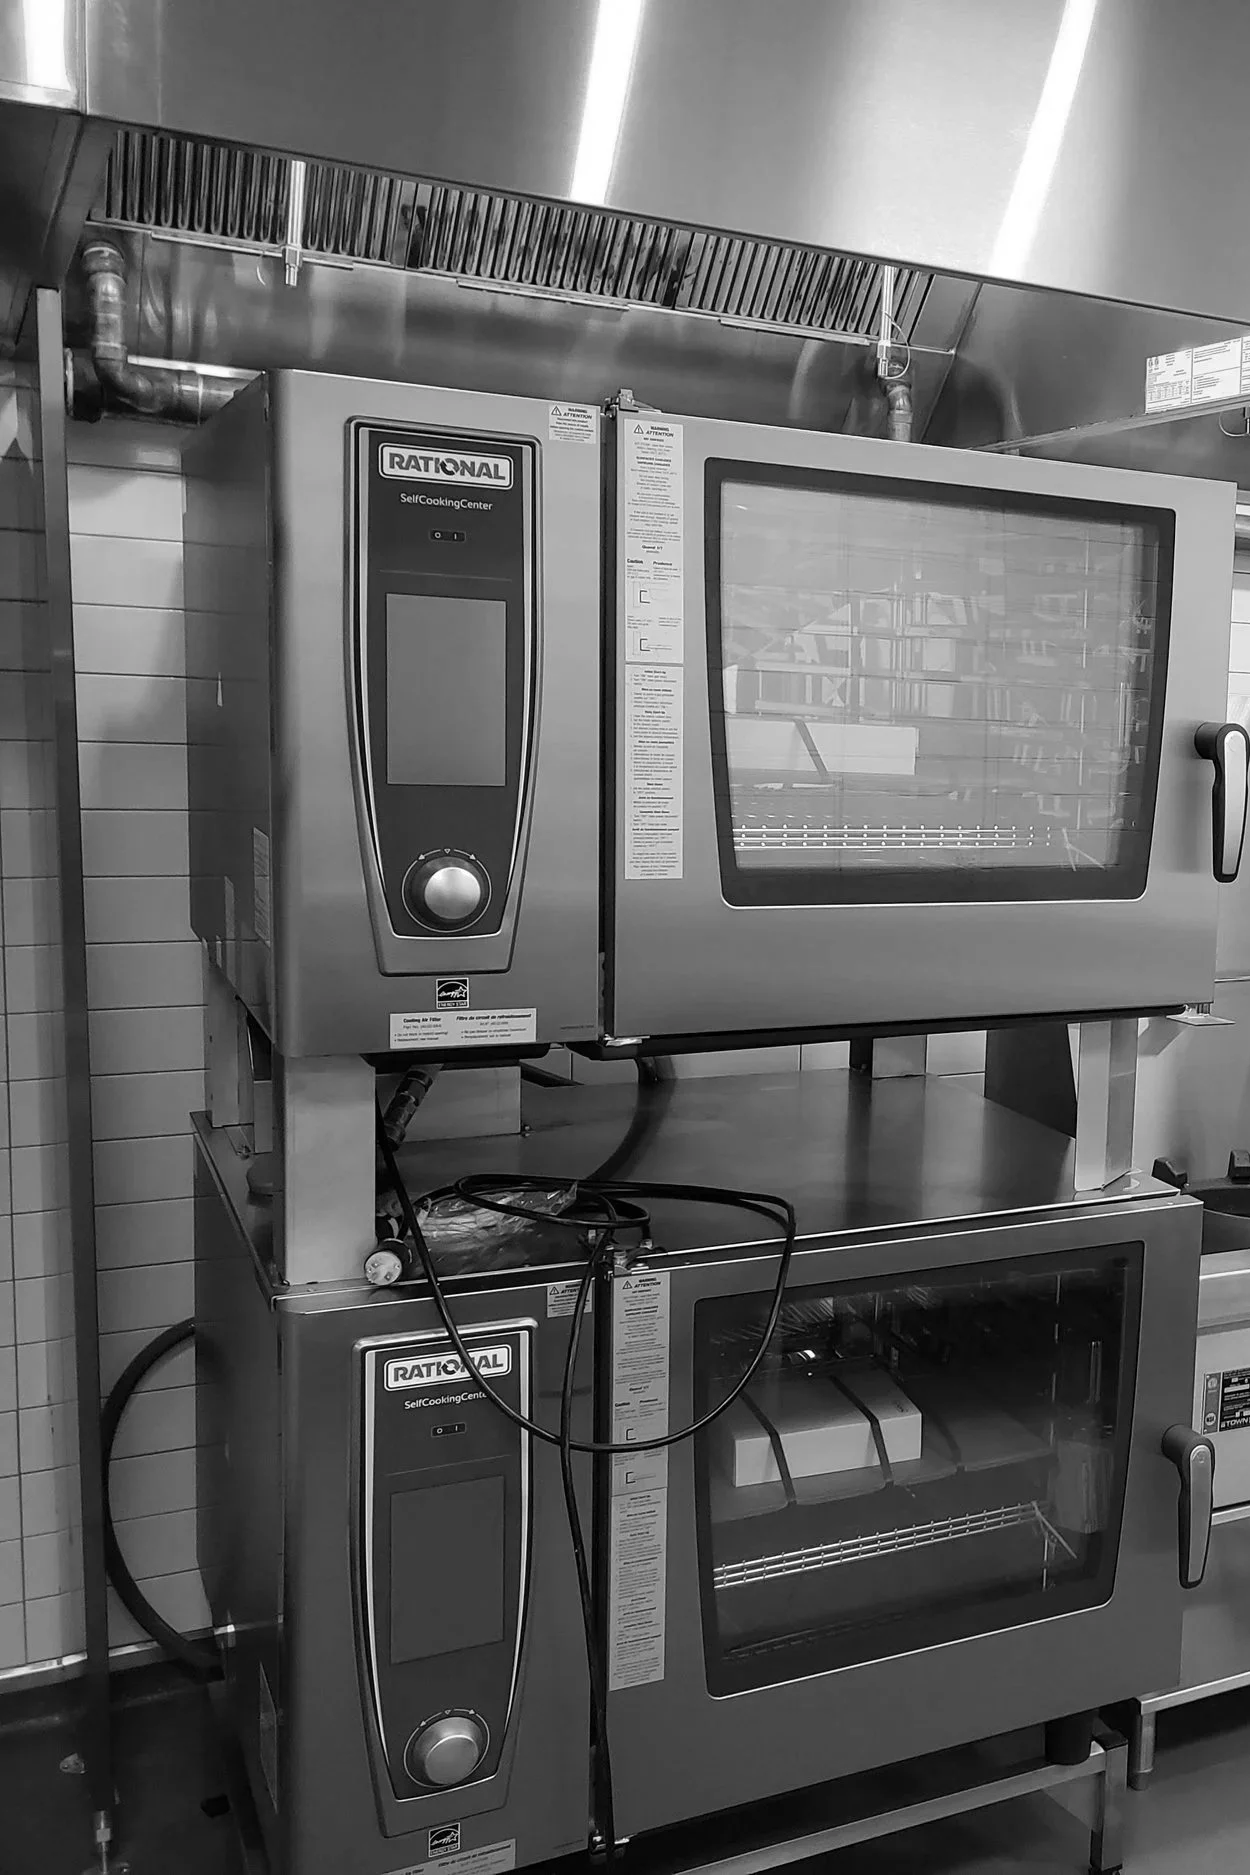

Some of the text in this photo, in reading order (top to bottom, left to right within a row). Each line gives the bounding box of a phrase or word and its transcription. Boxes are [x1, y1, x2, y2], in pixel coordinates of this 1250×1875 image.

[563, 412, 592, 420] ATTENTION
[645, 430, 674, 438] ATTENTION
[388, 452, 506, 481] RATIONAL
[400, 493, 493, 511] SelfCookingCenter
[393, 1353, 504, 1383] RATIOAL
[404, 1391, 487, 1410] SelfCookingCent
